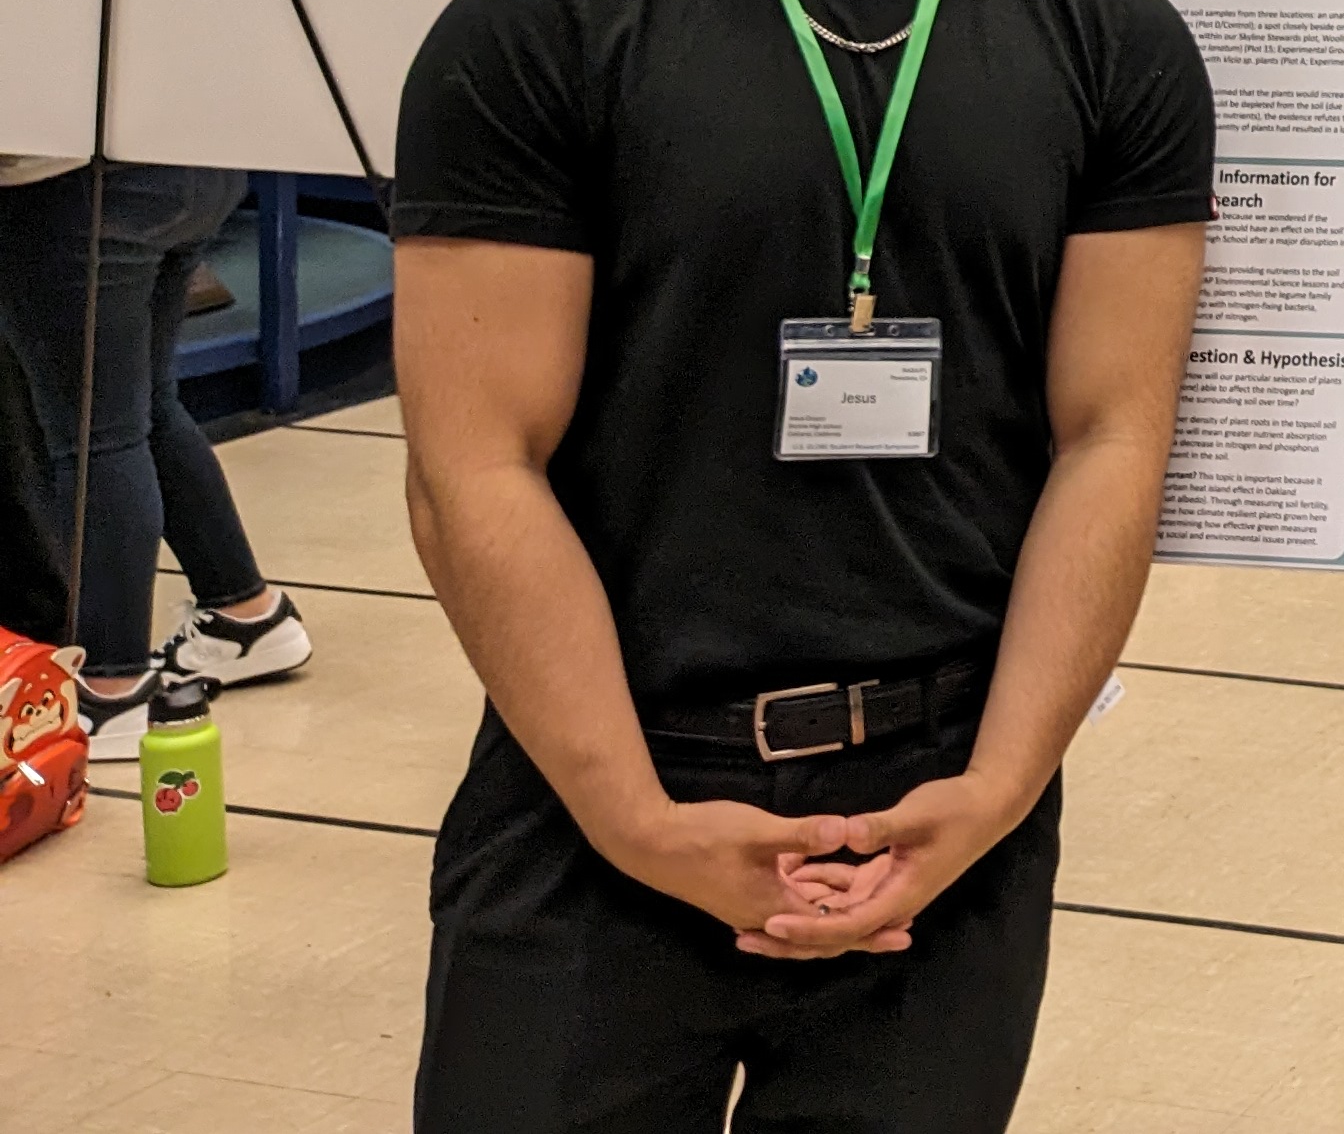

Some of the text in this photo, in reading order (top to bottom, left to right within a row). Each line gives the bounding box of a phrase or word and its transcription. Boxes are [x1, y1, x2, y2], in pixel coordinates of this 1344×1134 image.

[1219, 169, 1336, 186] Information for
[1216, 193, 1264, 208] search
[1187, 346, 1238, 363] estion
[1243, 349, 1255, 364] &
[840, 392, 876, 403] Jesus
